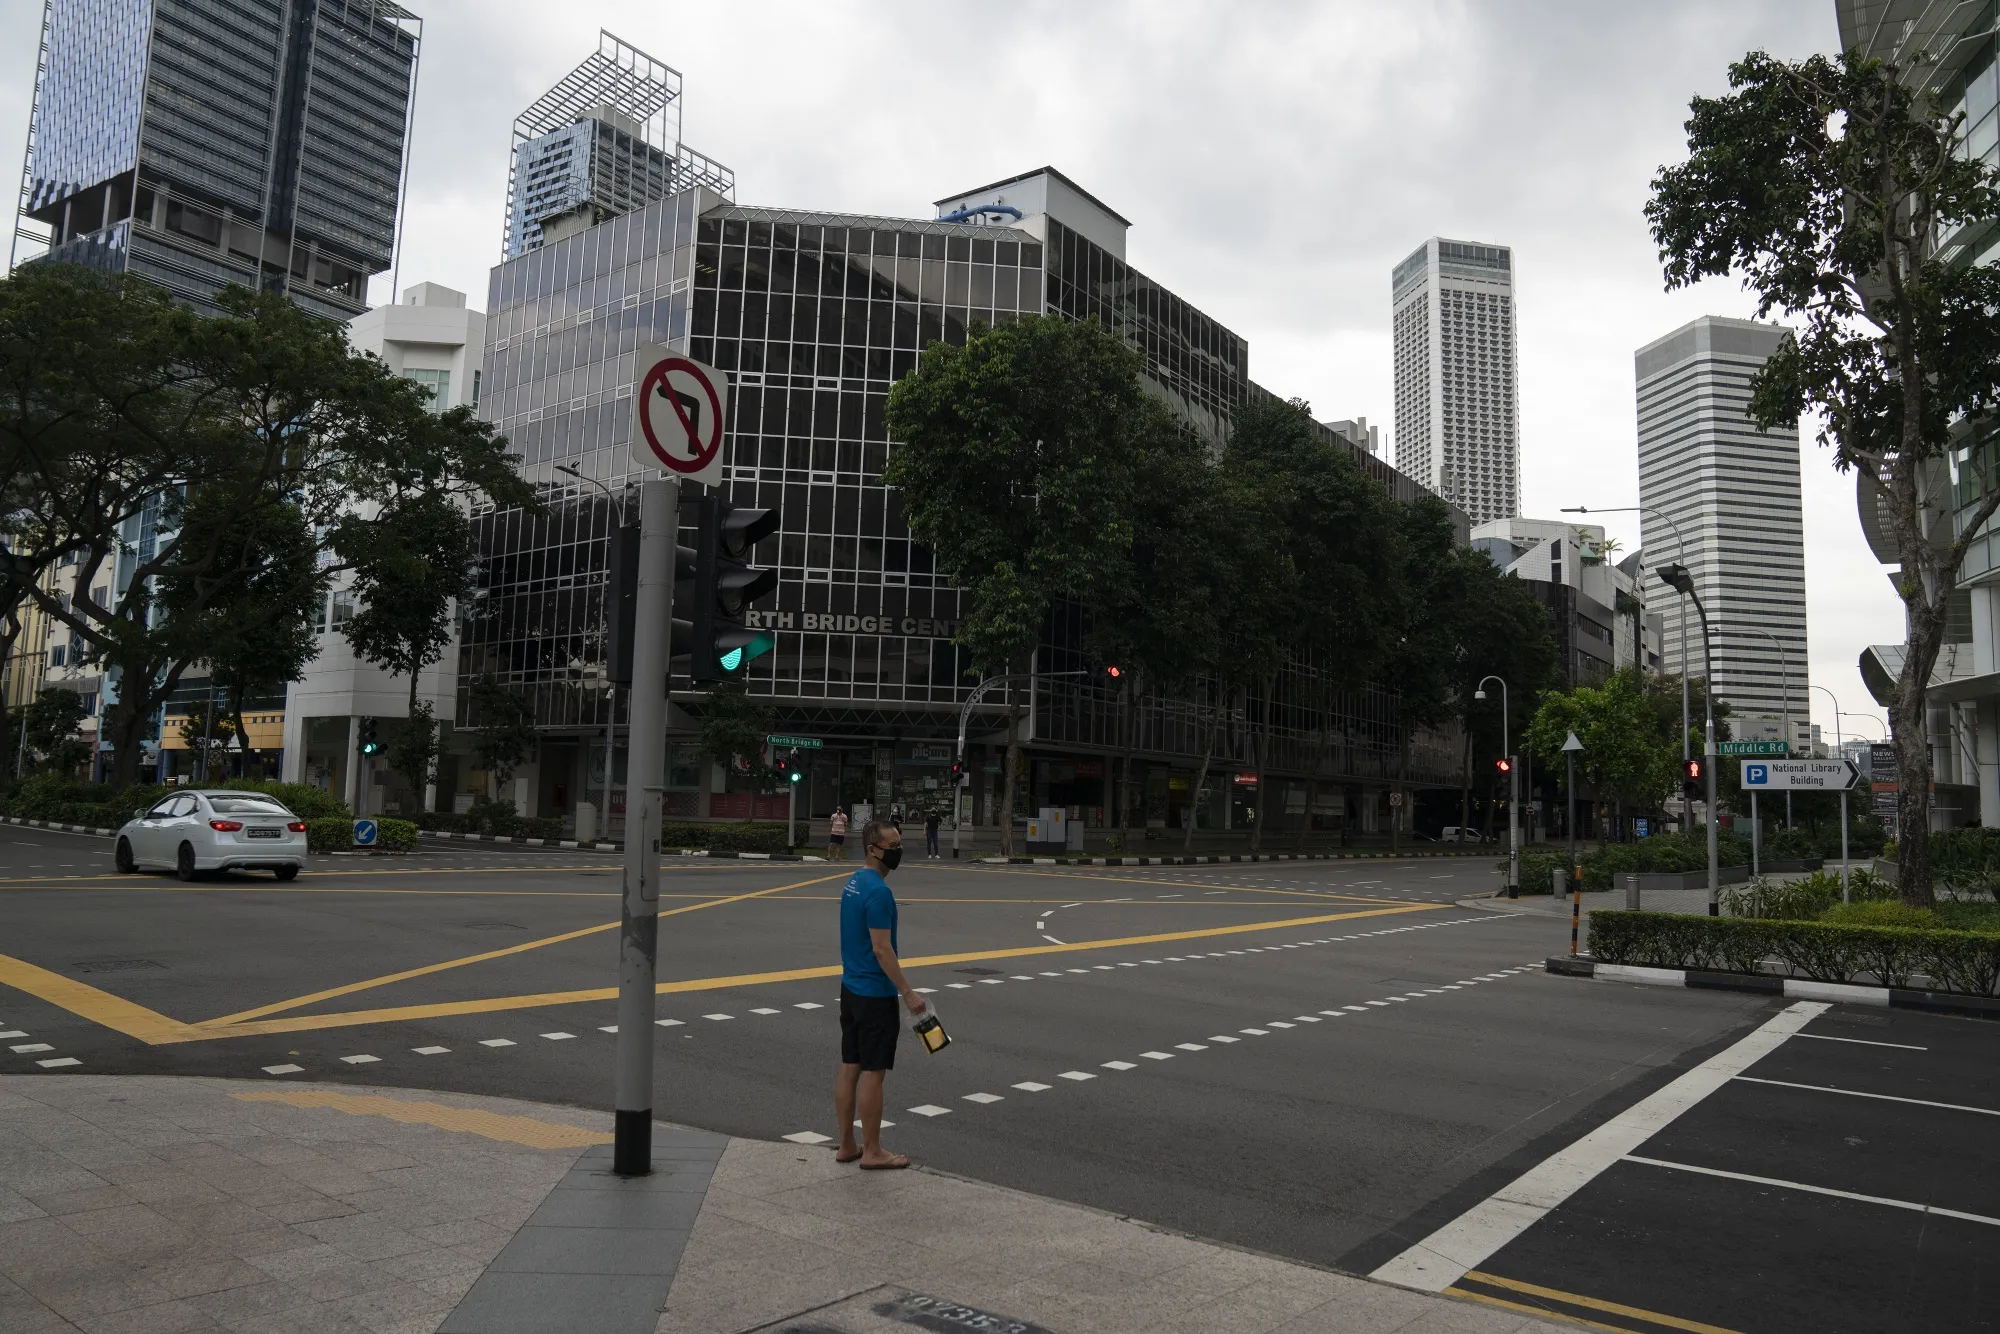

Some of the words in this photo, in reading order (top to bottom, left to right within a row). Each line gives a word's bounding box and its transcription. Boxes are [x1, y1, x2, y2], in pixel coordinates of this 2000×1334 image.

[745, 610, 794, 628] RTH
[802, 613, 893, 633] BRIDGE
[771, 736, 790, 744] North
[791, 738, 812, 747] Bridge
[1724, 742, 1764, 753] Middle
[1769, 743, 1784, 752] Rd
[1772, 763, 1807, 773] National
[1811, 763, 1841, 774] Library
[1790, 775, 1824, 786] Building
